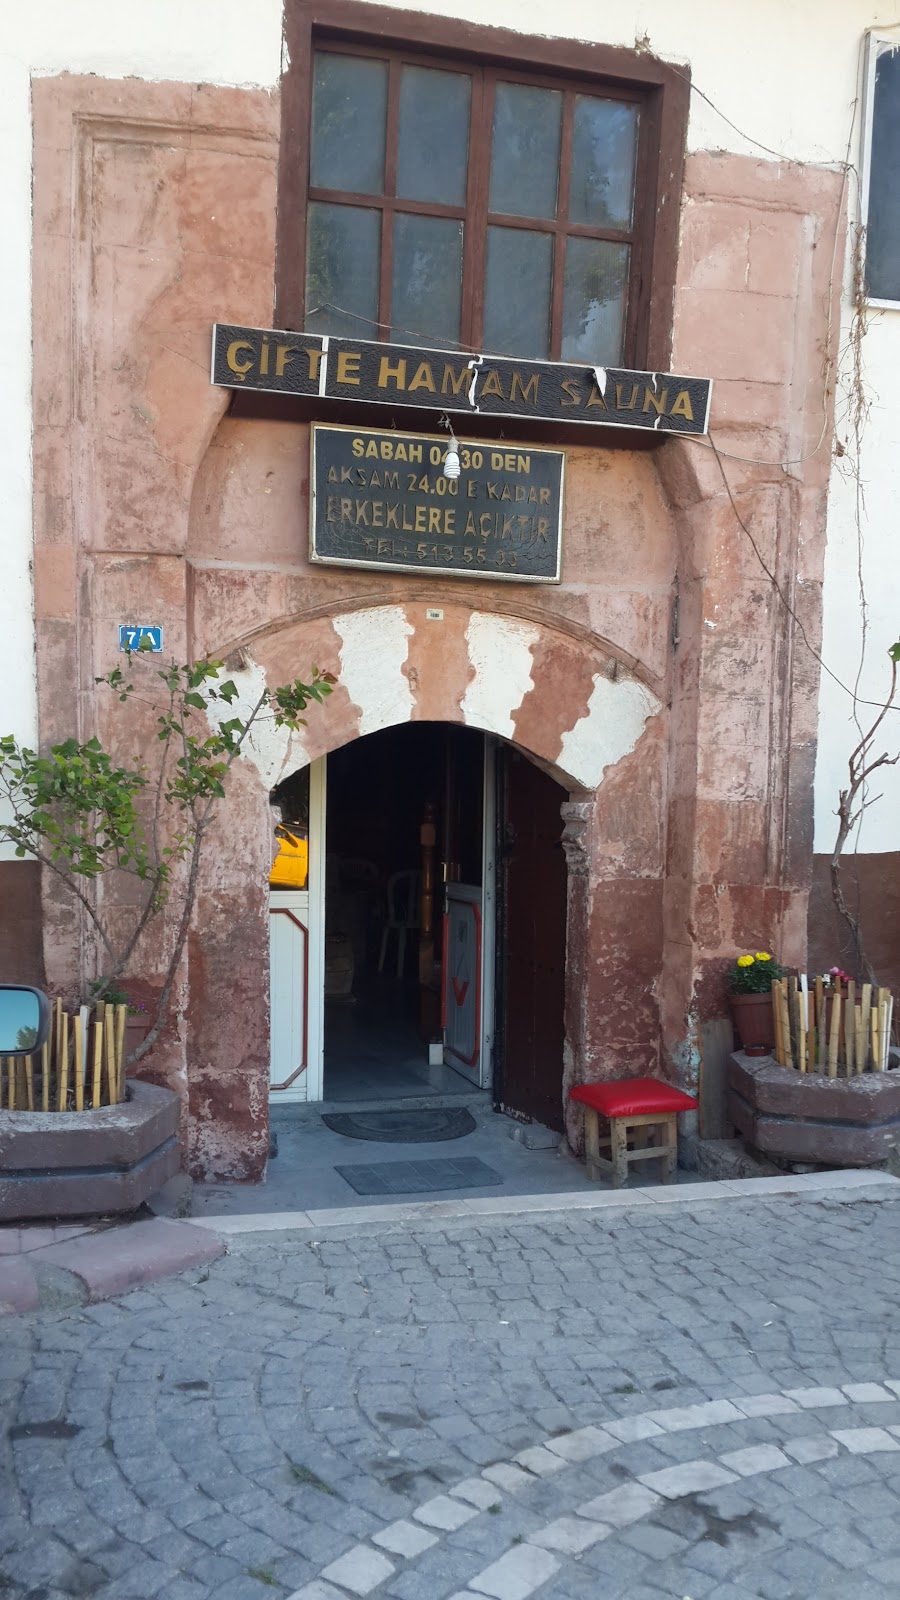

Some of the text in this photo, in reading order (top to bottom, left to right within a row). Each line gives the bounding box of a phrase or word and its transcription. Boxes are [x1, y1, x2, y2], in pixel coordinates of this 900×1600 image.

[226, 336, 694, 422] ÇİFTE HAMAM SAUNA
[352, 438, 423, 464] SABAH
[491, 452, 531, 474] DEN
[326, 465, 400, 491] AKŞAM
[407, 473, 459, 497] 24.00
[486, 481, 551, 505] KADAR
[325, 495, 551, 544] ERKEKLERE AÇIKTIR
